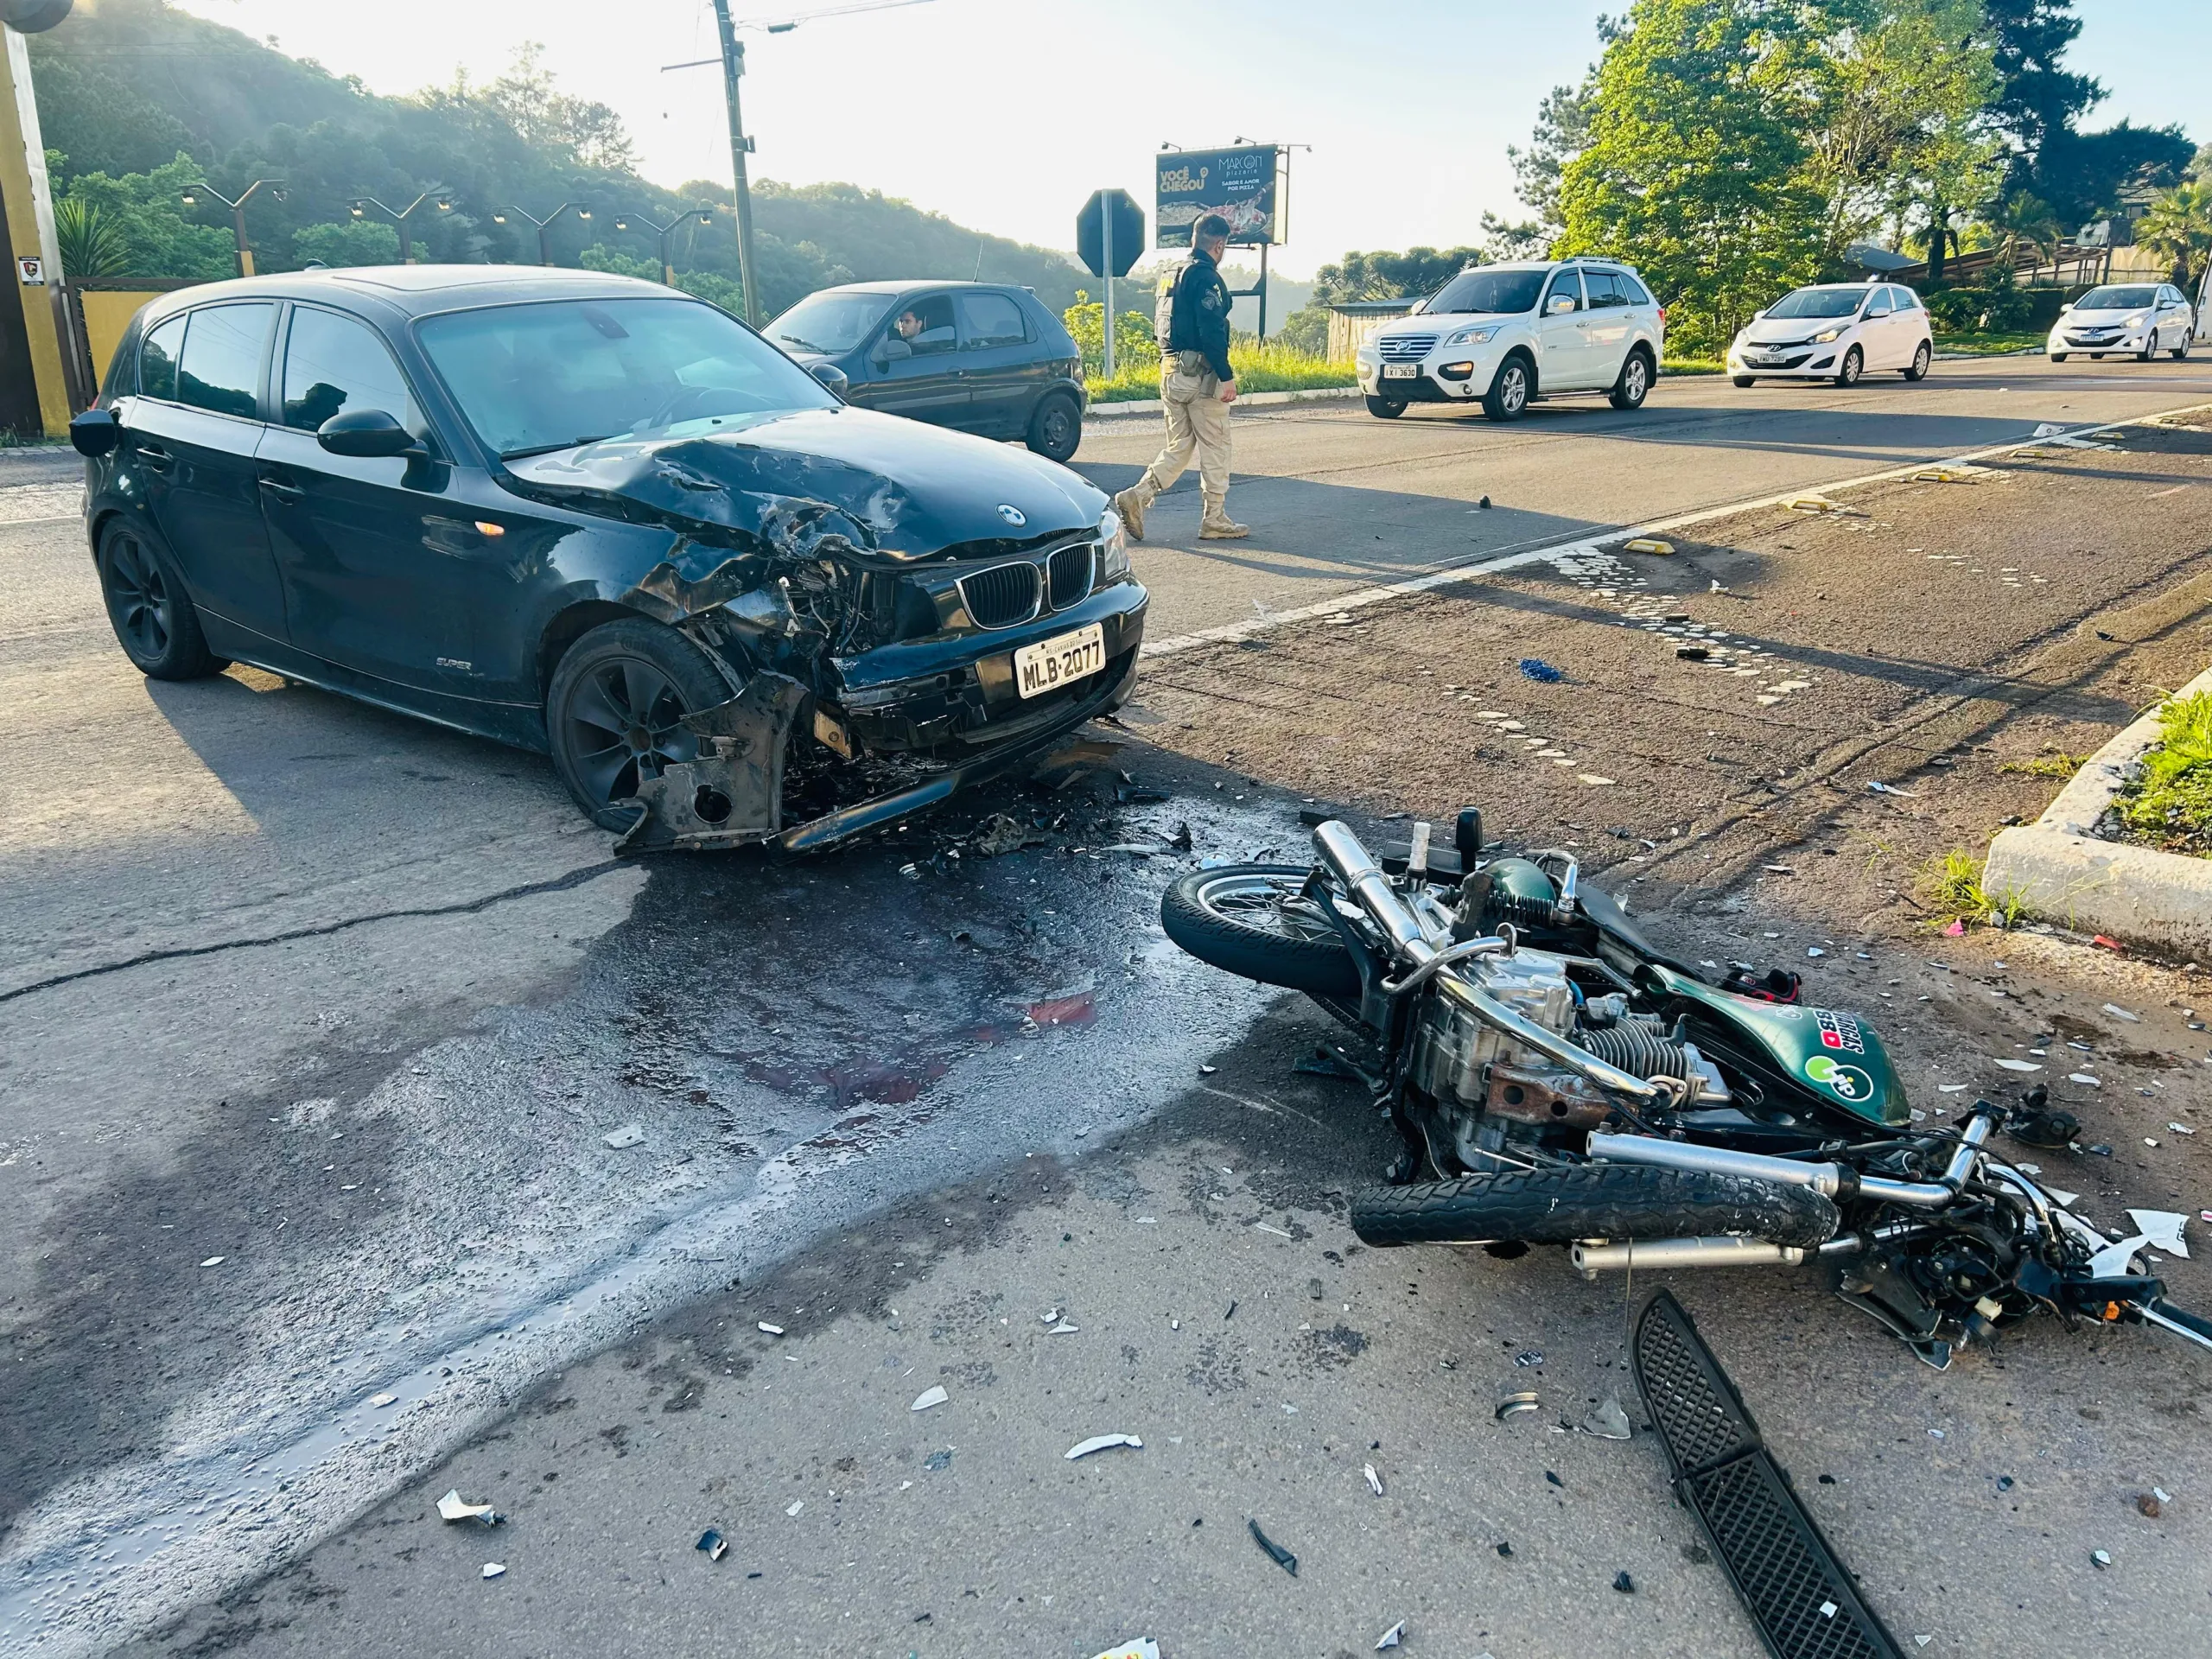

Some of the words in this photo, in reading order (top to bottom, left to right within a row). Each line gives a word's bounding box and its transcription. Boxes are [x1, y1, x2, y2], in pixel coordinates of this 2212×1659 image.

[1218, 155, 1262, 171] MARCON
[1160, 166, 1190, 181] VOCÊ
[1226, 168, 1257, 178] pizzaria
[1160, 178, 1205, 194] CHEGOU
[435, 657, 472, 671] SUPER
[1833, 1010, 1865, 1055] VARGAS
